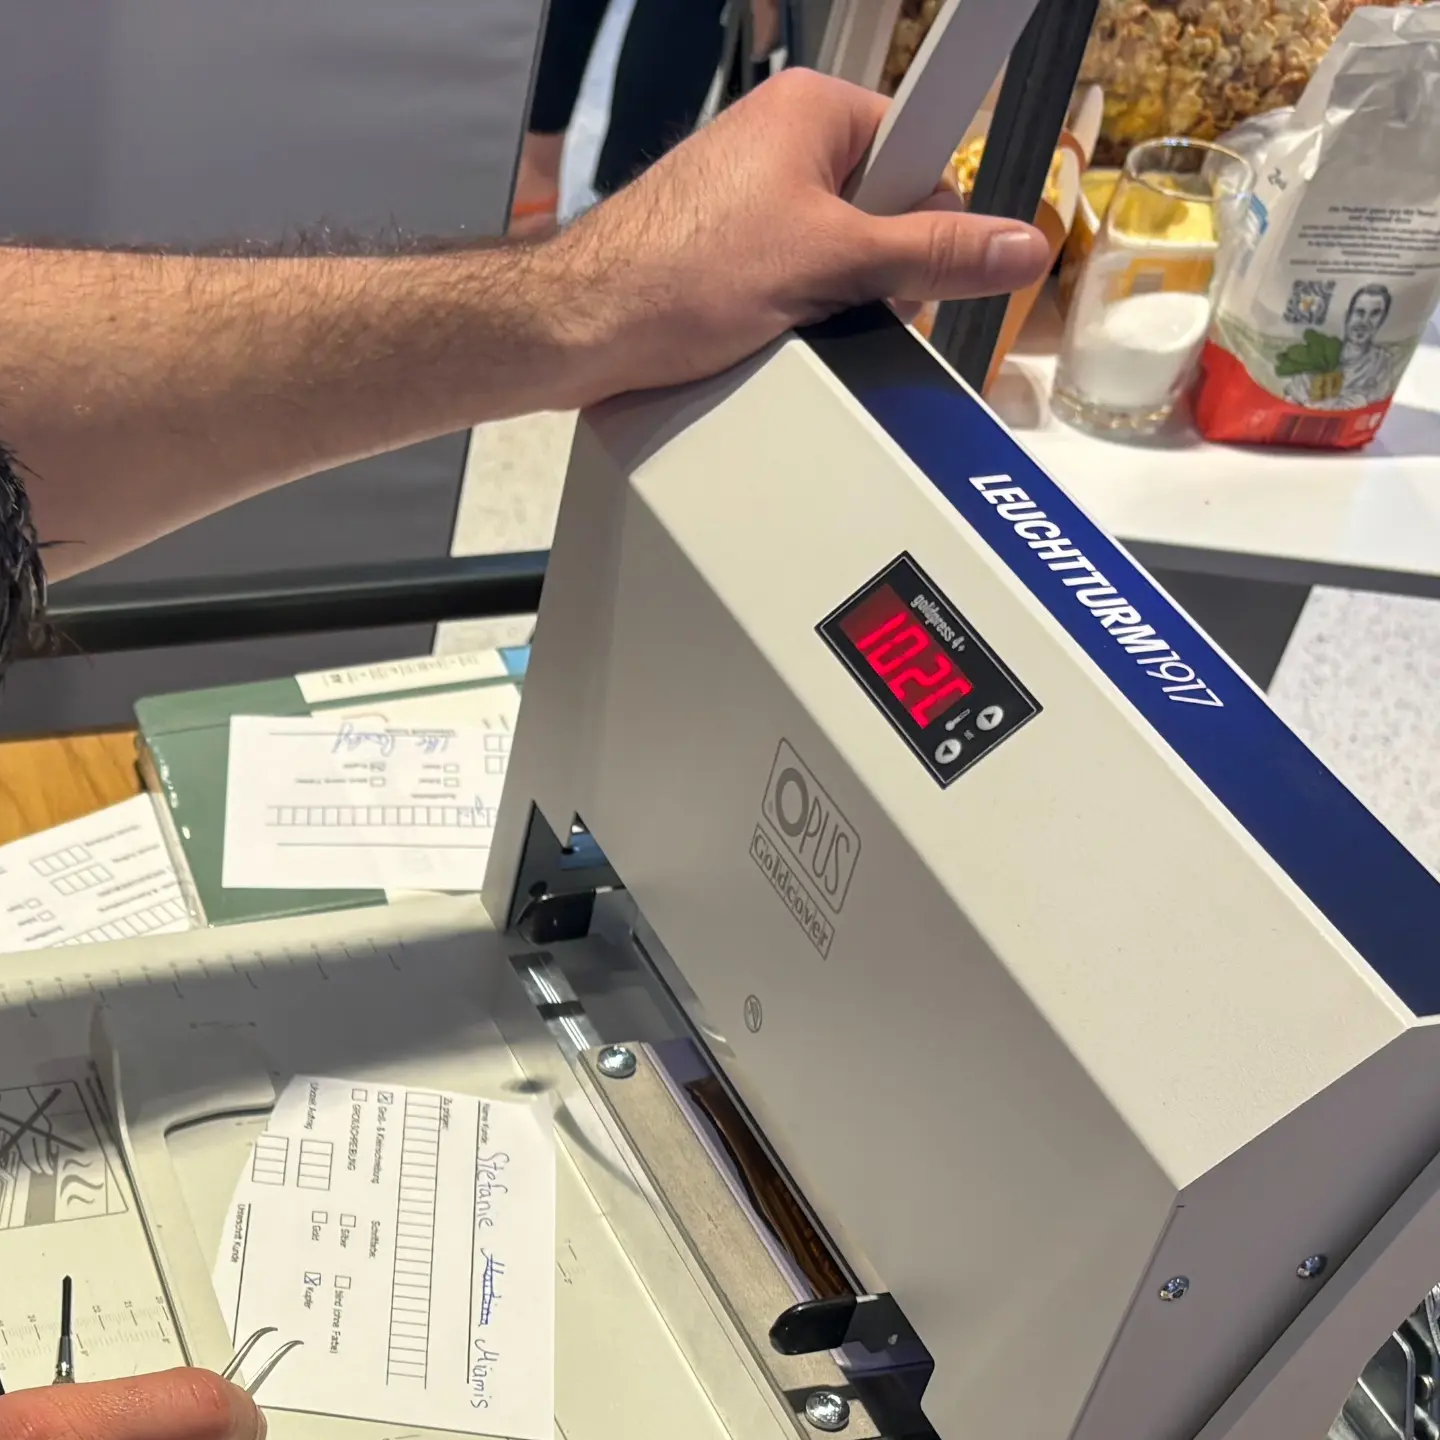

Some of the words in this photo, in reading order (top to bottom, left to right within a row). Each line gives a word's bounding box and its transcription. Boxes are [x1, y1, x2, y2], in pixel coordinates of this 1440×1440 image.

[910, 594, 955, 643] goldpress
[969, 474, 1224, 707] LEUCHTTURM1917
[774, 767, 850, 895] OPUS
[753, 833, 829, 948] Goldcover
[477, 1151, 510, 1229] Stefanie
